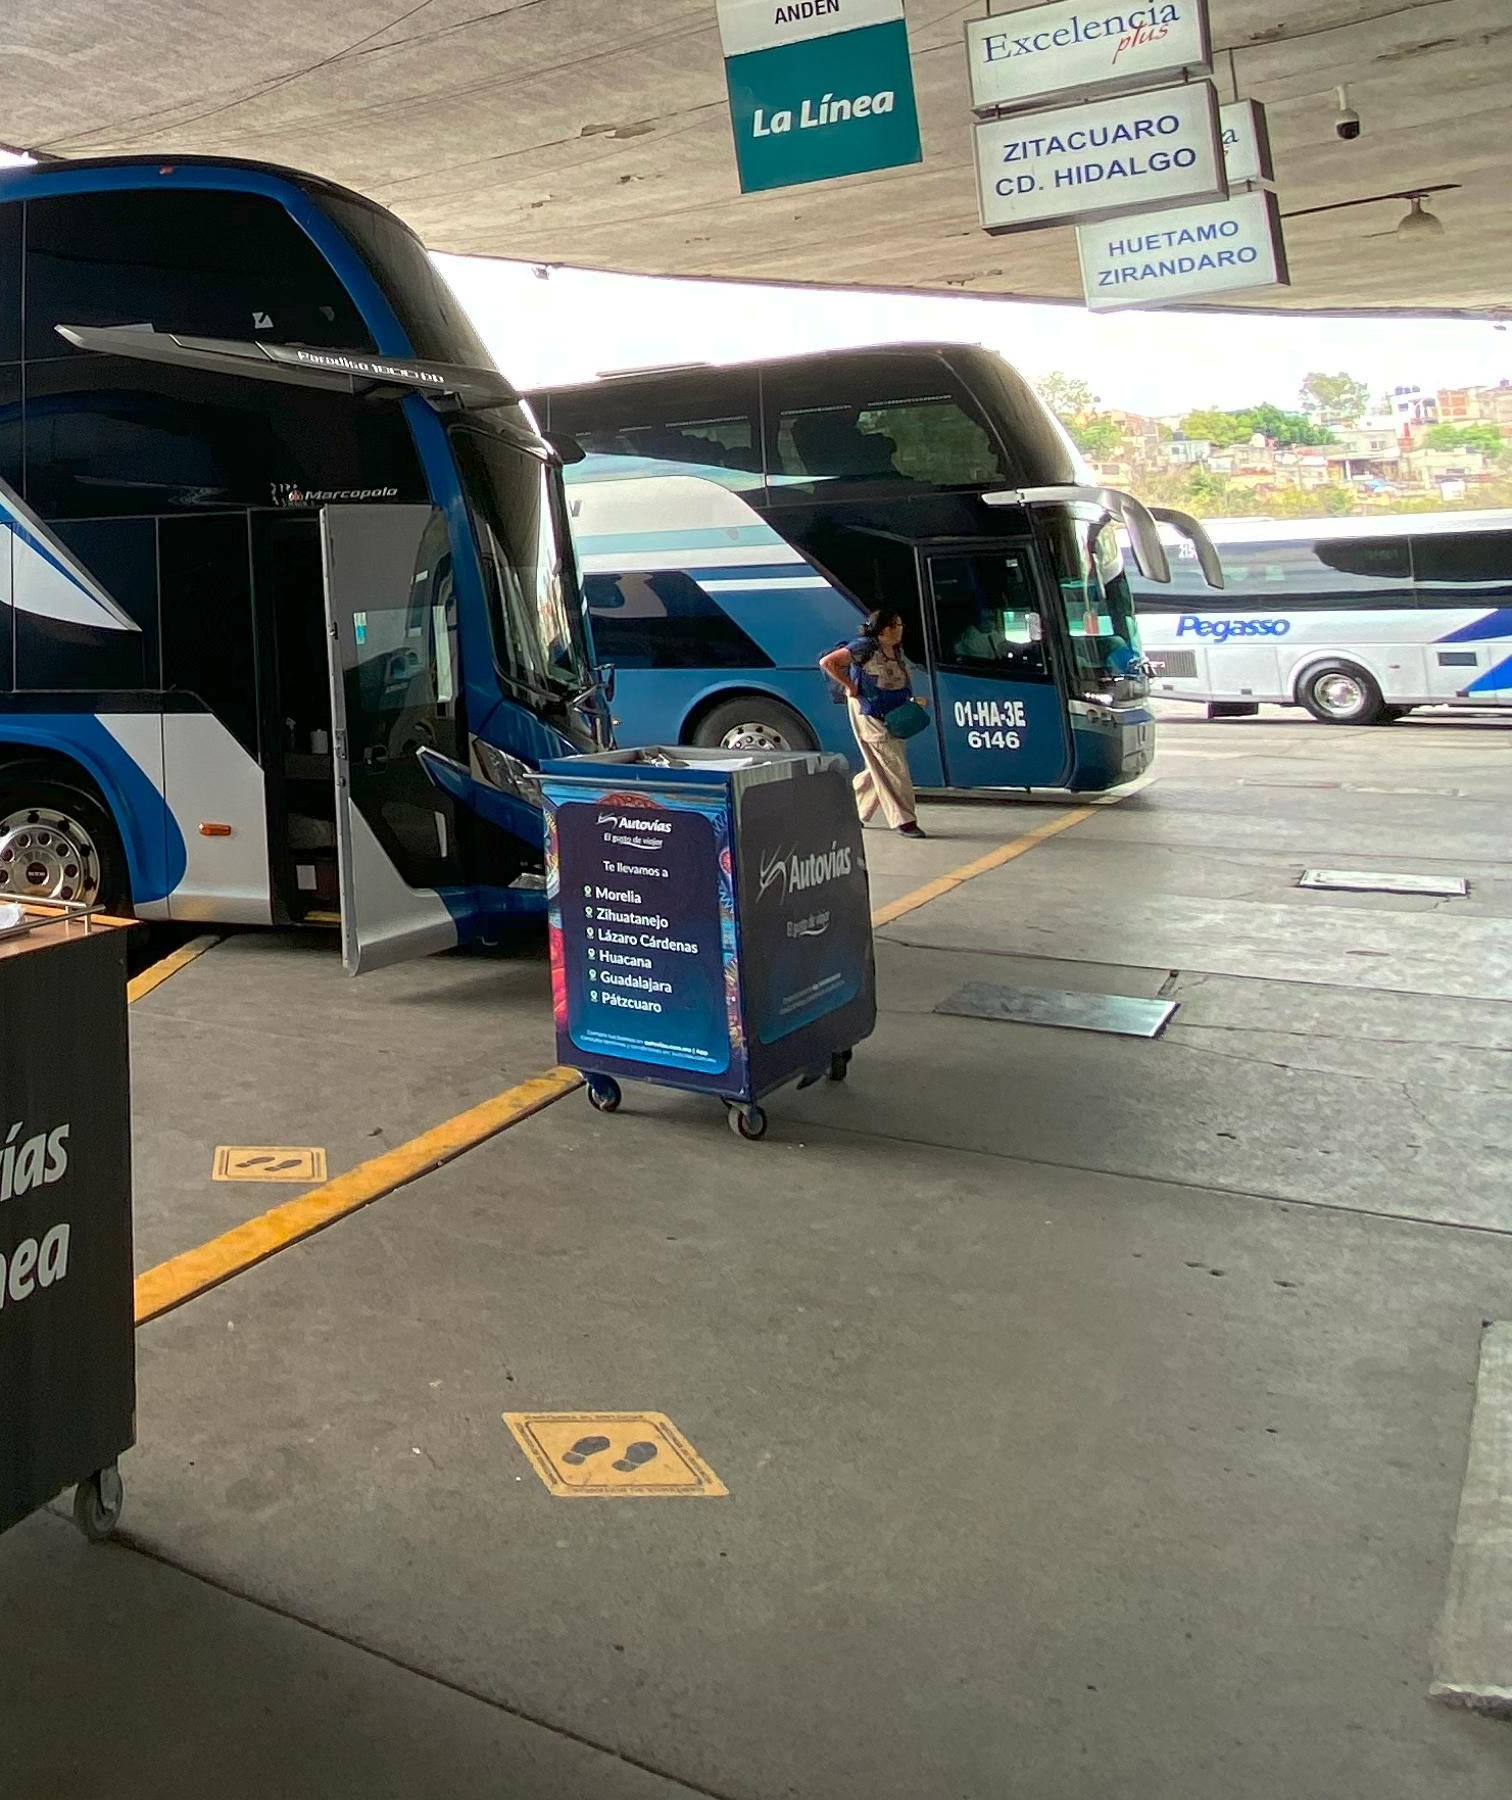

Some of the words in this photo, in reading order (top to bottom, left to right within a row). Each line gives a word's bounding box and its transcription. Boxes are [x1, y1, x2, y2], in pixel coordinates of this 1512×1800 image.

[774, 0, 840, 24] ANDEN
[981, 0, 1181, 63] Excelencia
[1112, 20, 1170, 65] plus
[752, 109, 792, 138] La
[800, 91, 895, 129] Línea
[1003, 115, 1180, 163] ZITACUARO
[995, 171, 1045, 197] CD.
[1053, 147, 1197, 188] HIDALGO
[1108, 220, 1240, 257] HUETAMO
[1097, 246, 1258, 288] ZIRANDARO
[305, 487, 398, 501] Marcopolo
[1176, 614, 1290, 642] Pegasso
[954, 700, 1026, 729] 01-HA-3E
[967, 730, 1021, 751] 6146
[618, 817, 672, 833] Autovías
[602, 860, 615, 872] Te
[616, 862, 660, 877] llevamos
[661, 869, 669, 878] a
[789, 840, 852, 894] Autovías
[595, 886, 642, 905] Morelia
[596, 906, 669, 930] Zihuatanejo
[597, 927, 638, 946] Lázaro
[640, 932, 698, 954] Cárdenas
[599, 949, 652, 969] Huacana
[600, 970, 673, 994] Guadalajara
[601, 991, 662, 1014] Pátzcuaro
